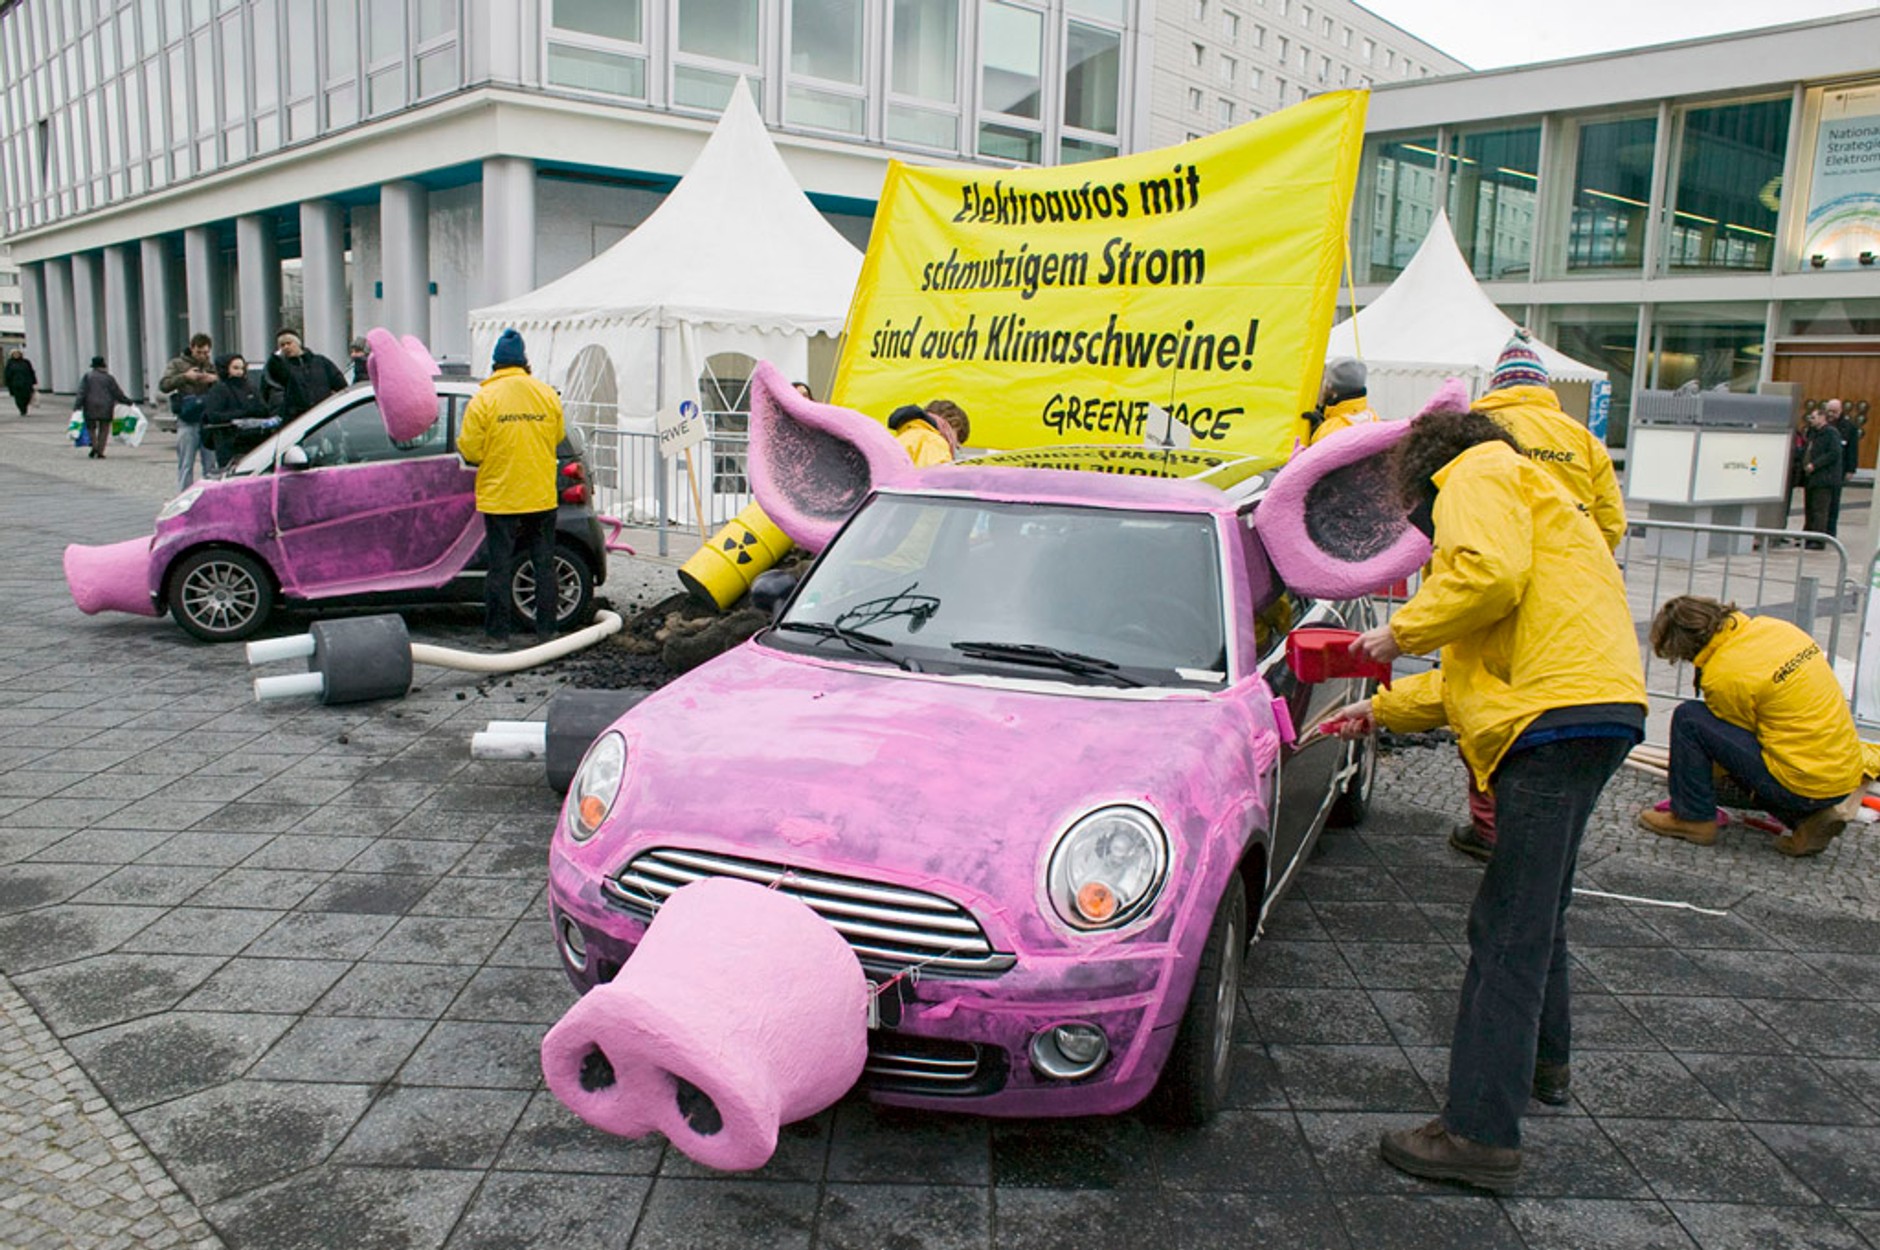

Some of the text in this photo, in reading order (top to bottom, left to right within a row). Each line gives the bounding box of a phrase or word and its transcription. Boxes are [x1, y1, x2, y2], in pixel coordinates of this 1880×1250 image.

[953, 164, 1200, 226] Elektroautos mit
[922, 237, 1205, 300] schmutzigem Strom
[870, 313, 1260, 372] sind auch Klimaschweine!
[660, 420, 690, 444] RWE
[1042, 393, 1245, 440] GREENPACE
